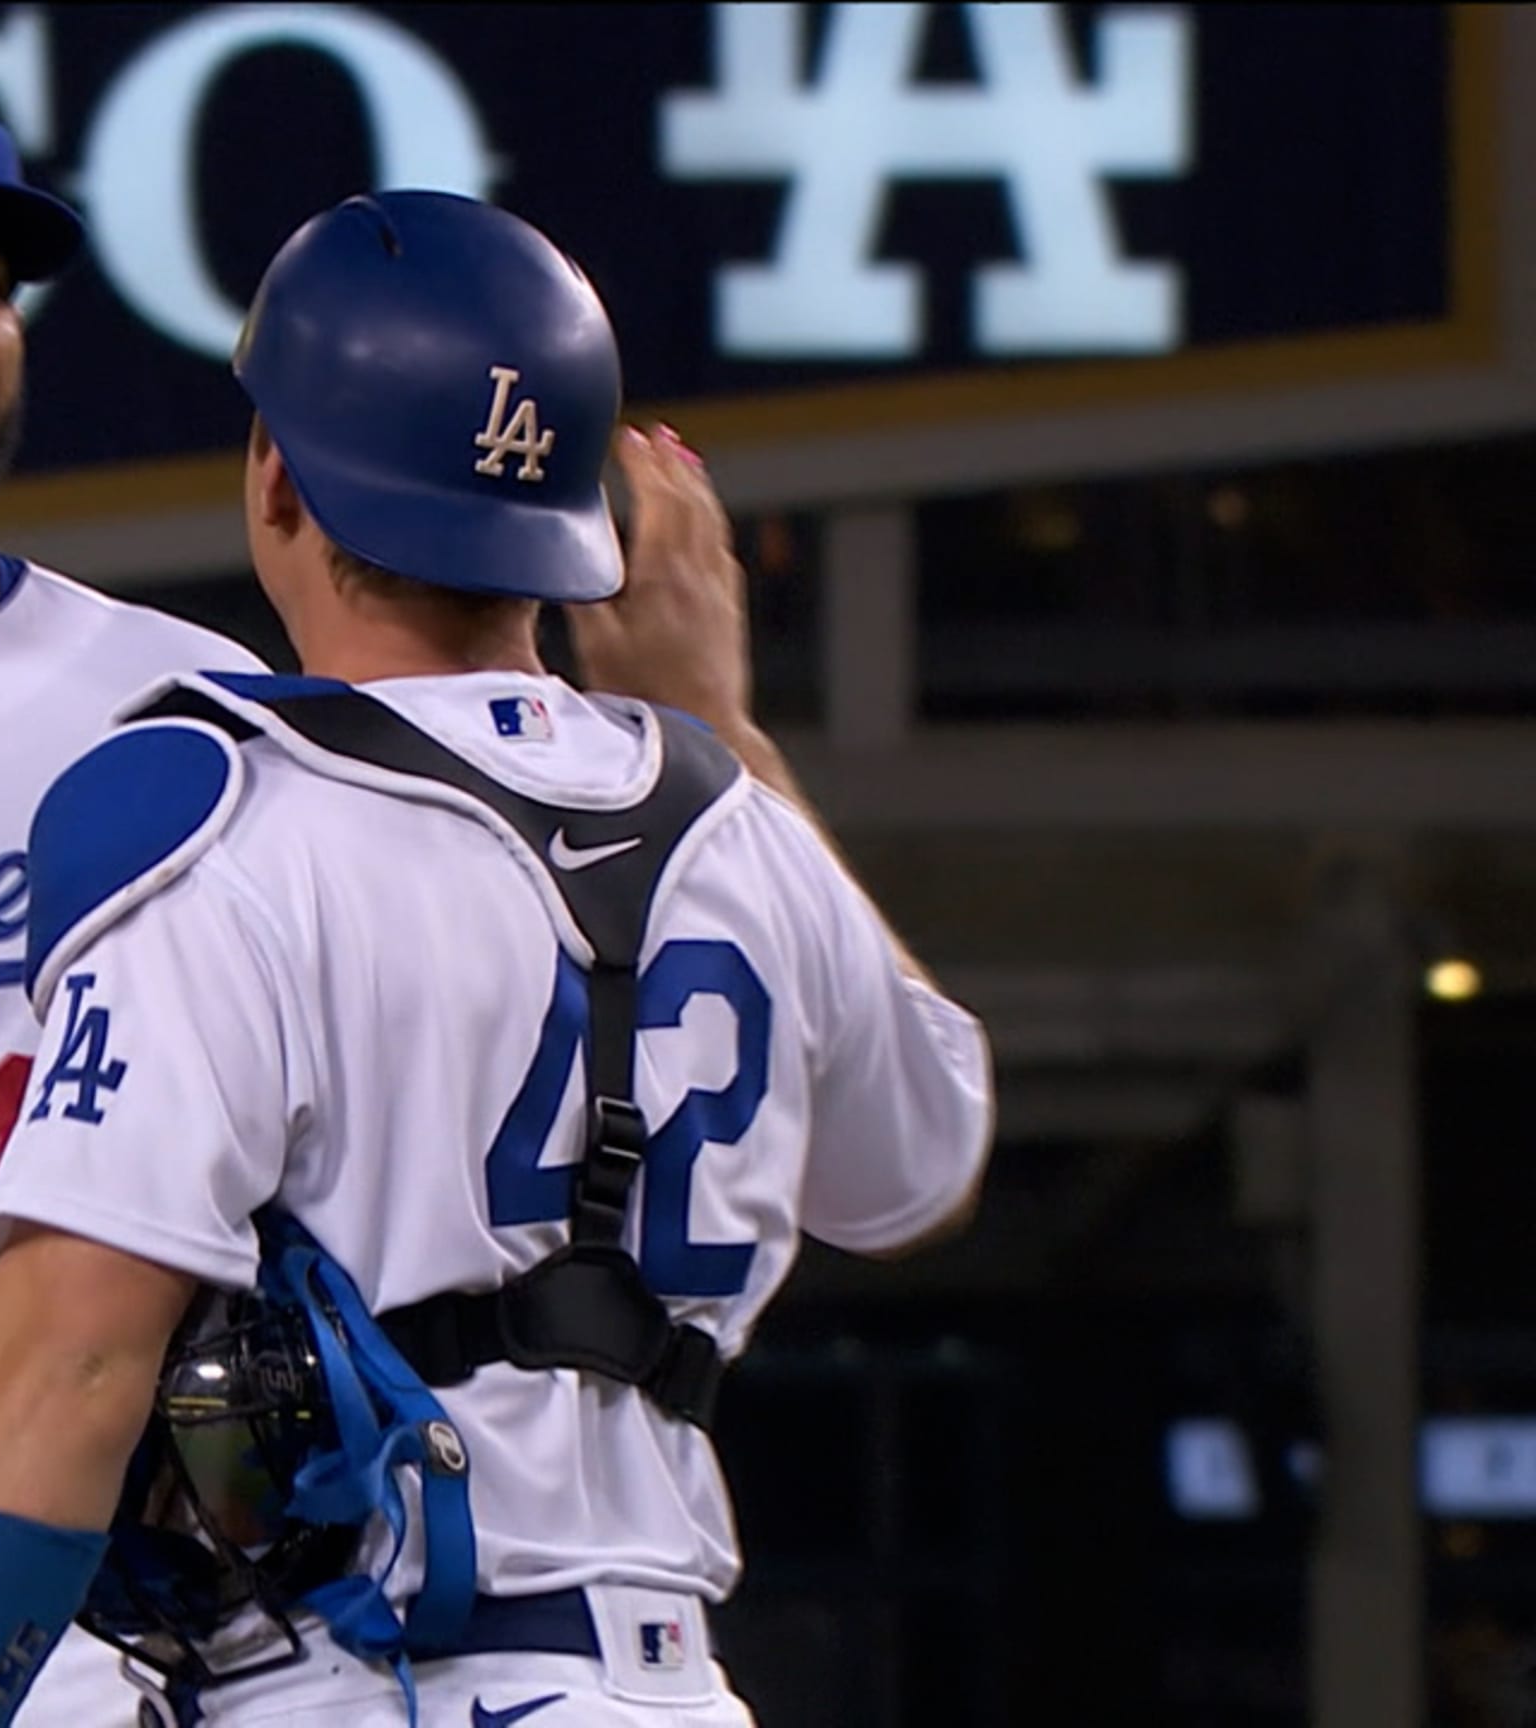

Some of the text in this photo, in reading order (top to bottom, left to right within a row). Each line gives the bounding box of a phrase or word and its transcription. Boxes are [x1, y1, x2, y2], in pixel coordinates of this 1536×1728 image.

[474, 366, 555, 480] LA
[28, 973, 127, 1125] LA
[486, 940, 770, 1296] 42
